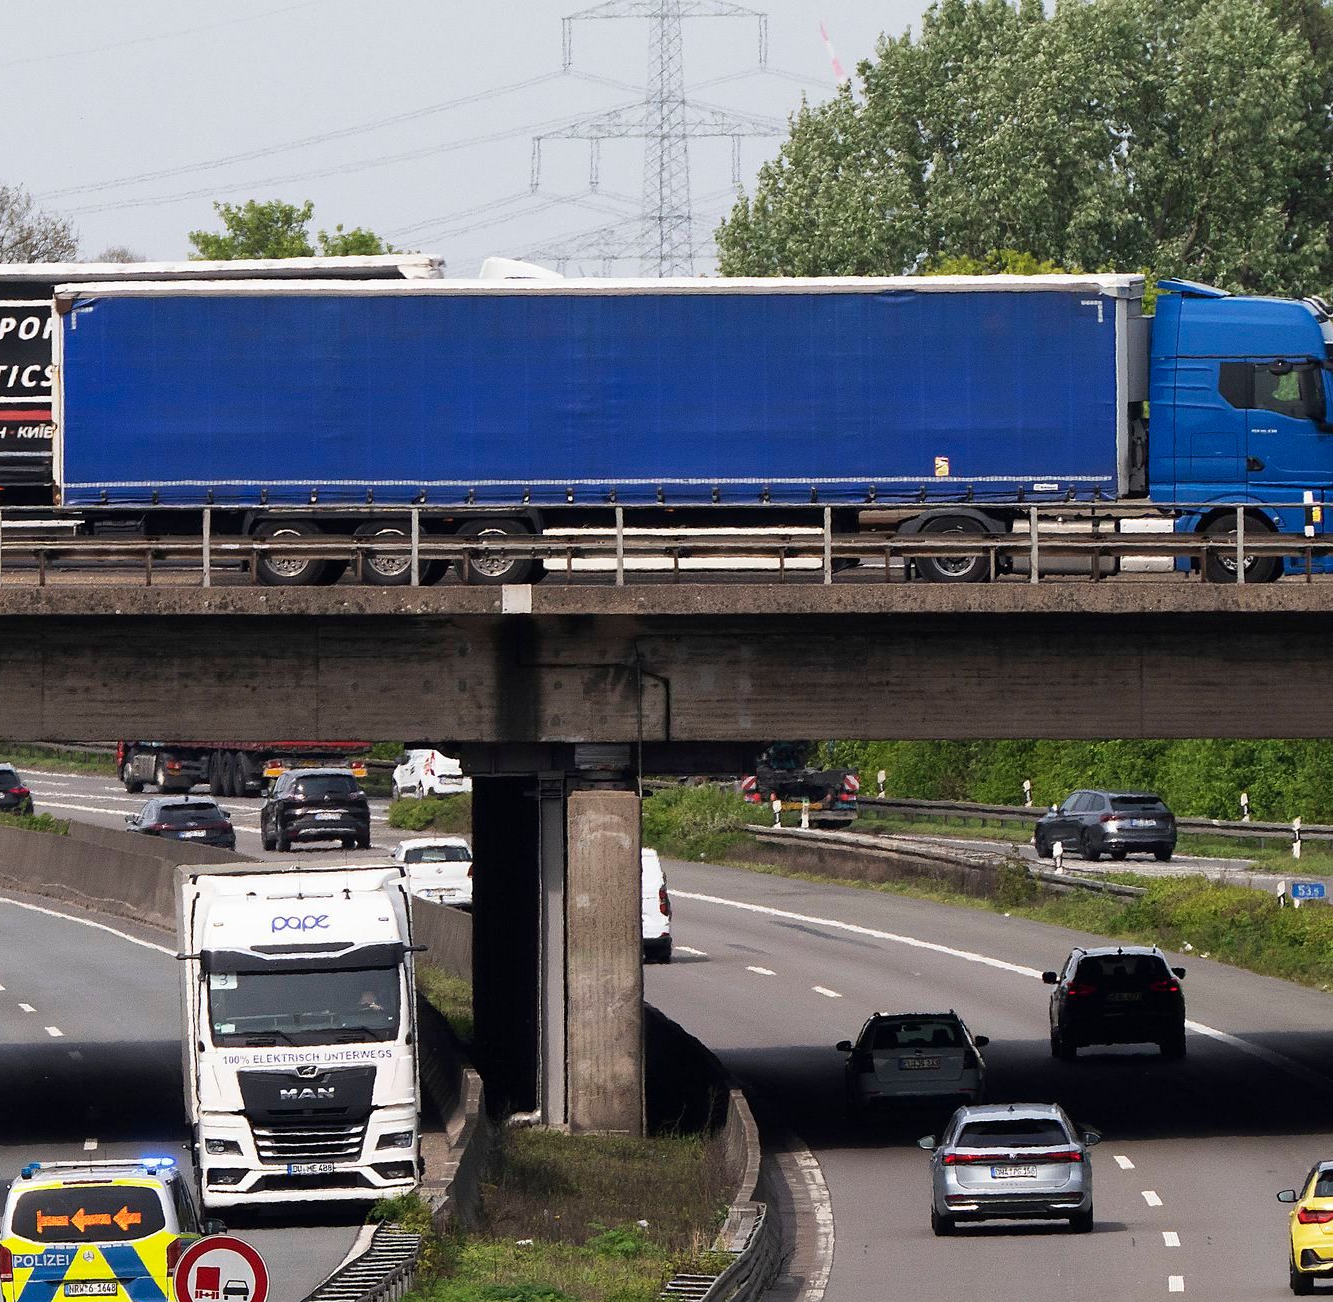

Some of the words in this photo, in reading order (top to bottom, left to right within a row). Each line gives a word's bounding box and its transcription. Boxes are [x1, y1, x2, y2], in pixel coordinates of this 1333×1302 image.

[271, 914, 330, 932] pape
[223, 1056, 250, 1065] 100%
[253, 1055, 320, 1064] ELEKTRISCH
[324, 1050, 392, 1061] UNTERWEGS
[280, 1087, 335, 1100] MAN
[13, 1254, 70, 1268] POLIZEI
